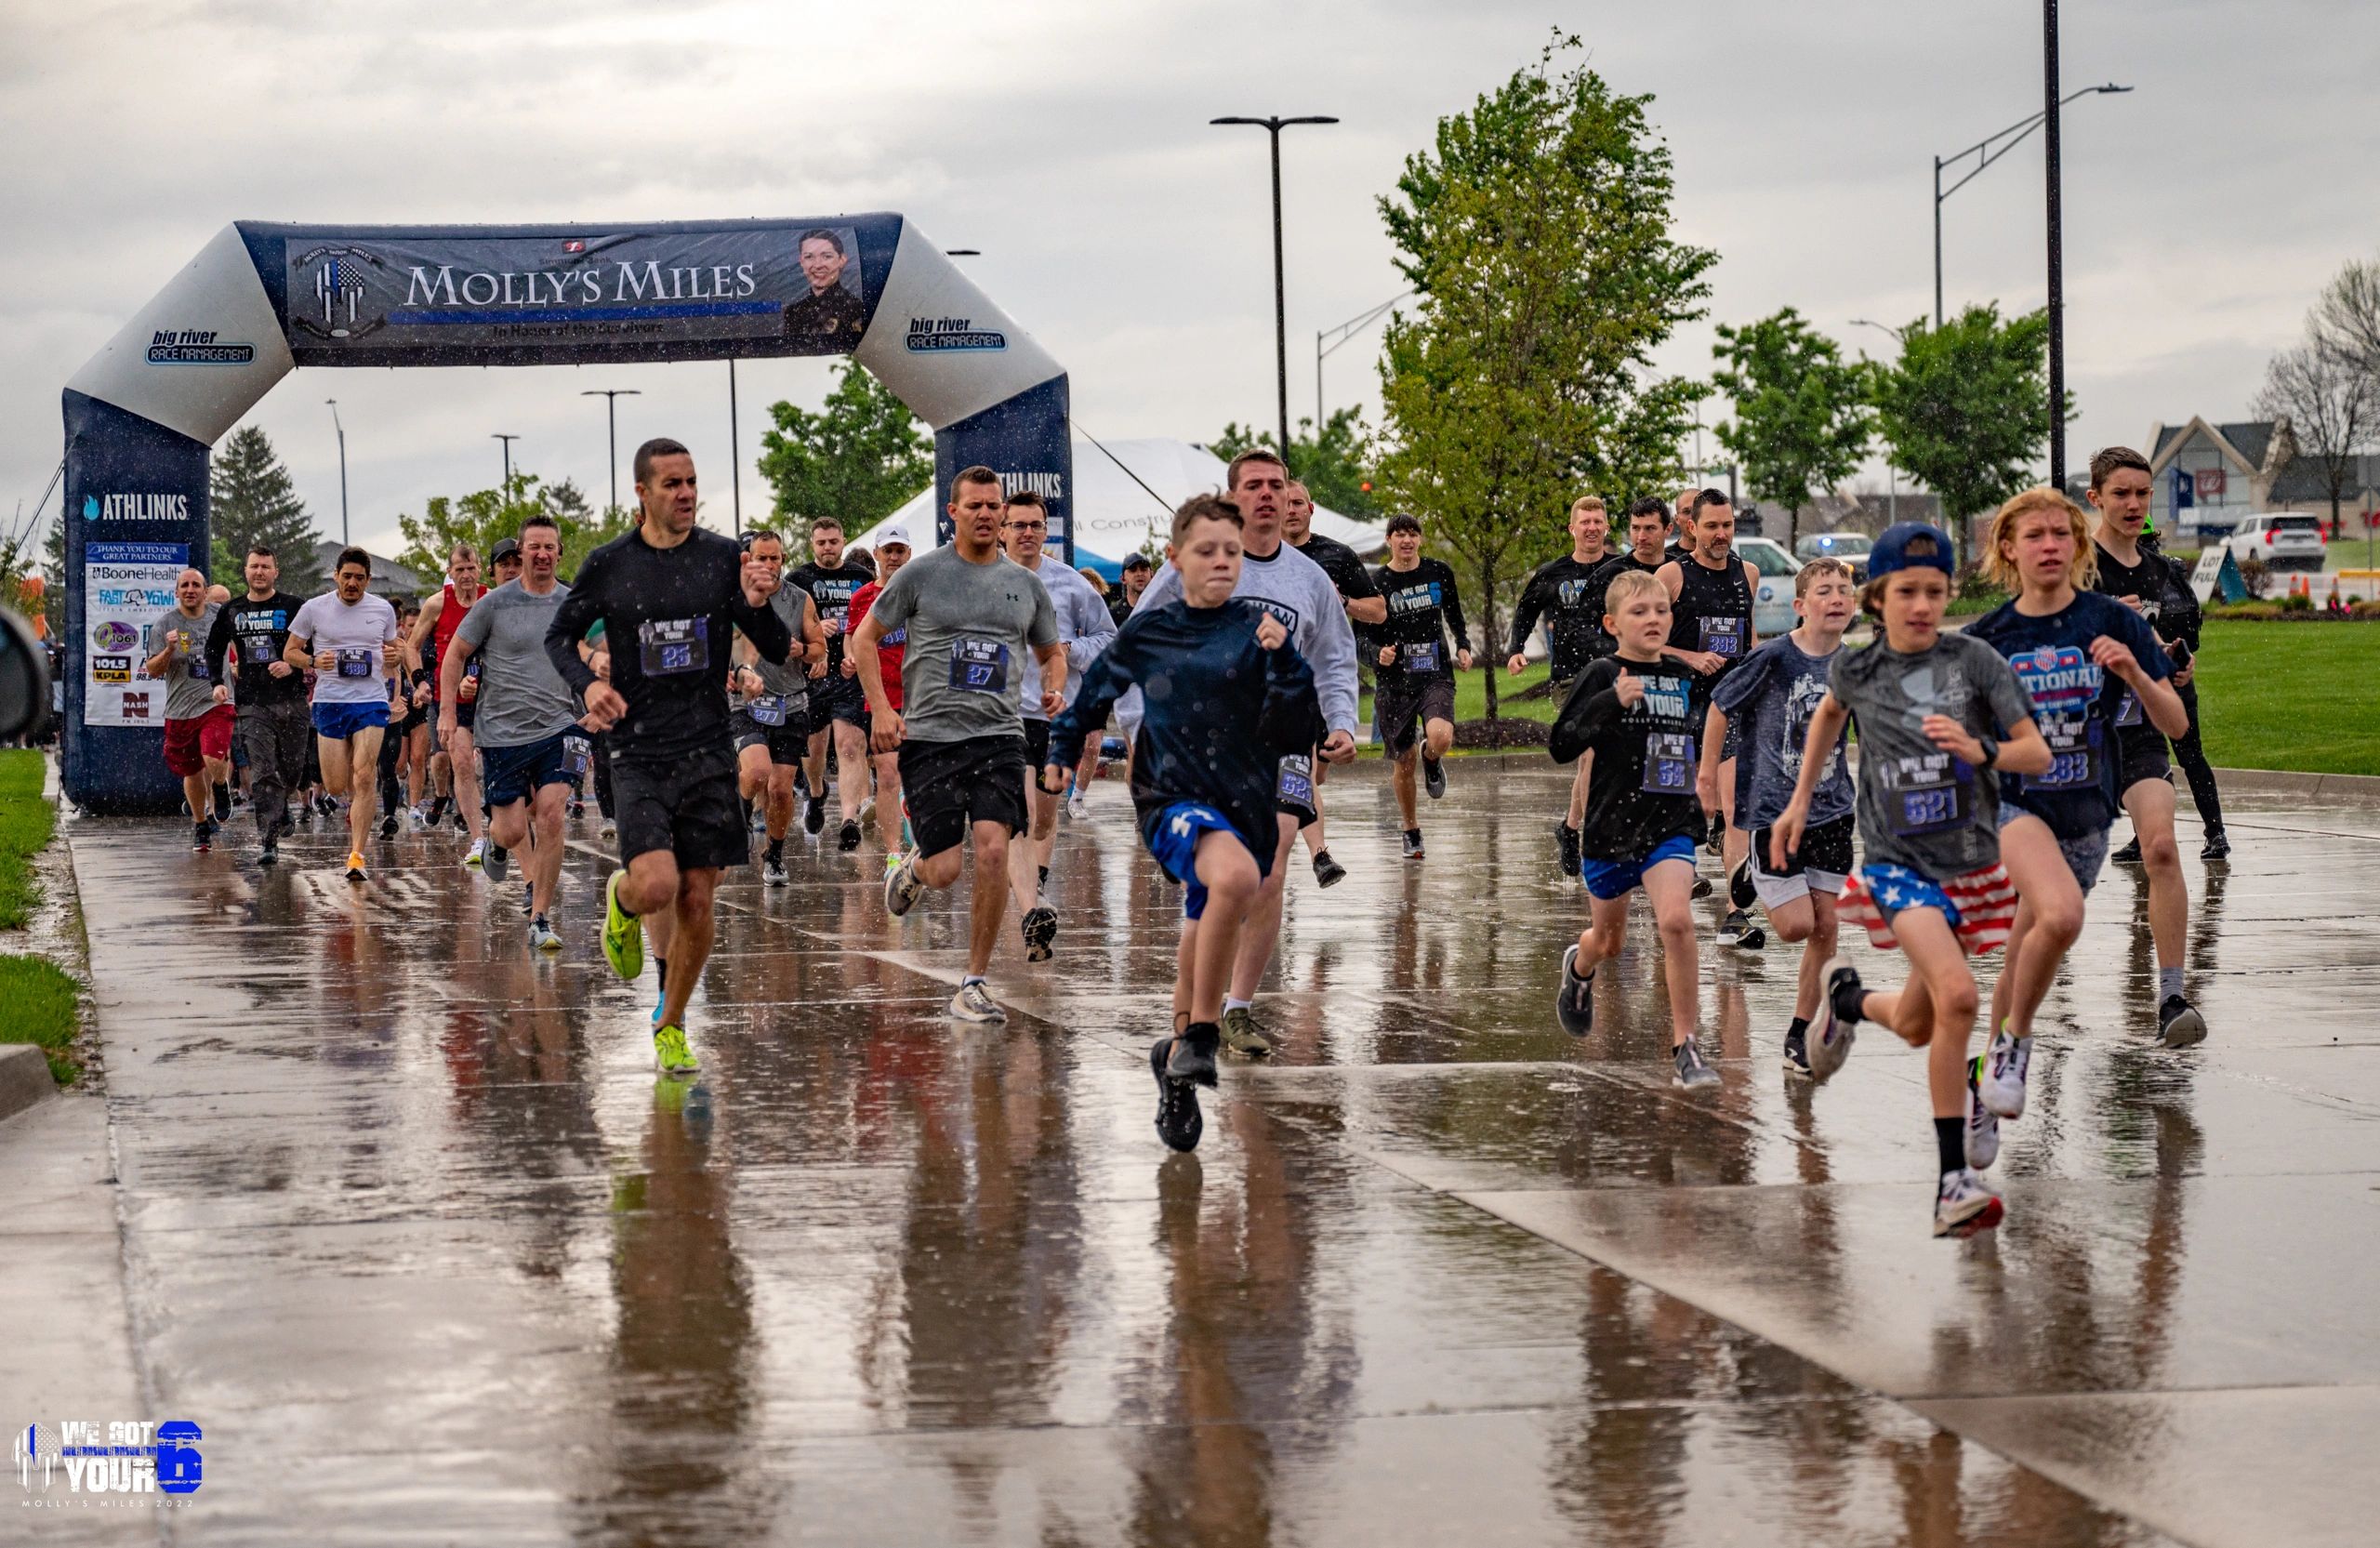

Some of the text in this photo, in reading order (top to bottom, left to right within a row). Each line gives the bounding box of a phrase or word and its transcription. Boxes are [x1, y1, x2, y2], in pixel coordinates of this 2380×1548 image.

[403, 259, 756, 309] MOLLY'S MILES
[910, 316, 971, 335] big river
[152, 328, 218, 345] big river
[909, 335, 1002, 349] RACE MANAGEMENT
[151, 348, 250, 361] RACE MANAGEMENT
[102, 494, 188, 521] ATHLINKS
[98, 545, 178, 554] THANK YOU TO OUR
[130, 552, 172, 561] PARTNERS
[2203, 557, 2221, 567] LOT
[2194, 572, 2216, 583] FULL
[99, 589, 126, 605] FAST
[826, 589, 852, 601] YOUR
[1404, 594, 1433, 611] YOUR
[247, 619, 273, 630] YOUR
[654, 618, 692, 632] WE GOT
[1712, 616, 1737, 626] WE GOT
[967, 641, 998, 654] WE GOT
[95, 658, 127, 669] 101.5
[95, 671, 126, 680] KPLA
[966, 664, 994, 685] 27
[1658, 675, 1681, 692] GOT
[1643, 694, 1686, 719] YOUR
[2060, 721, 2085, 735] GOT
[1898, 753, 1950, 774] WE GOT
[1903, 787, 1959, 826] 621
